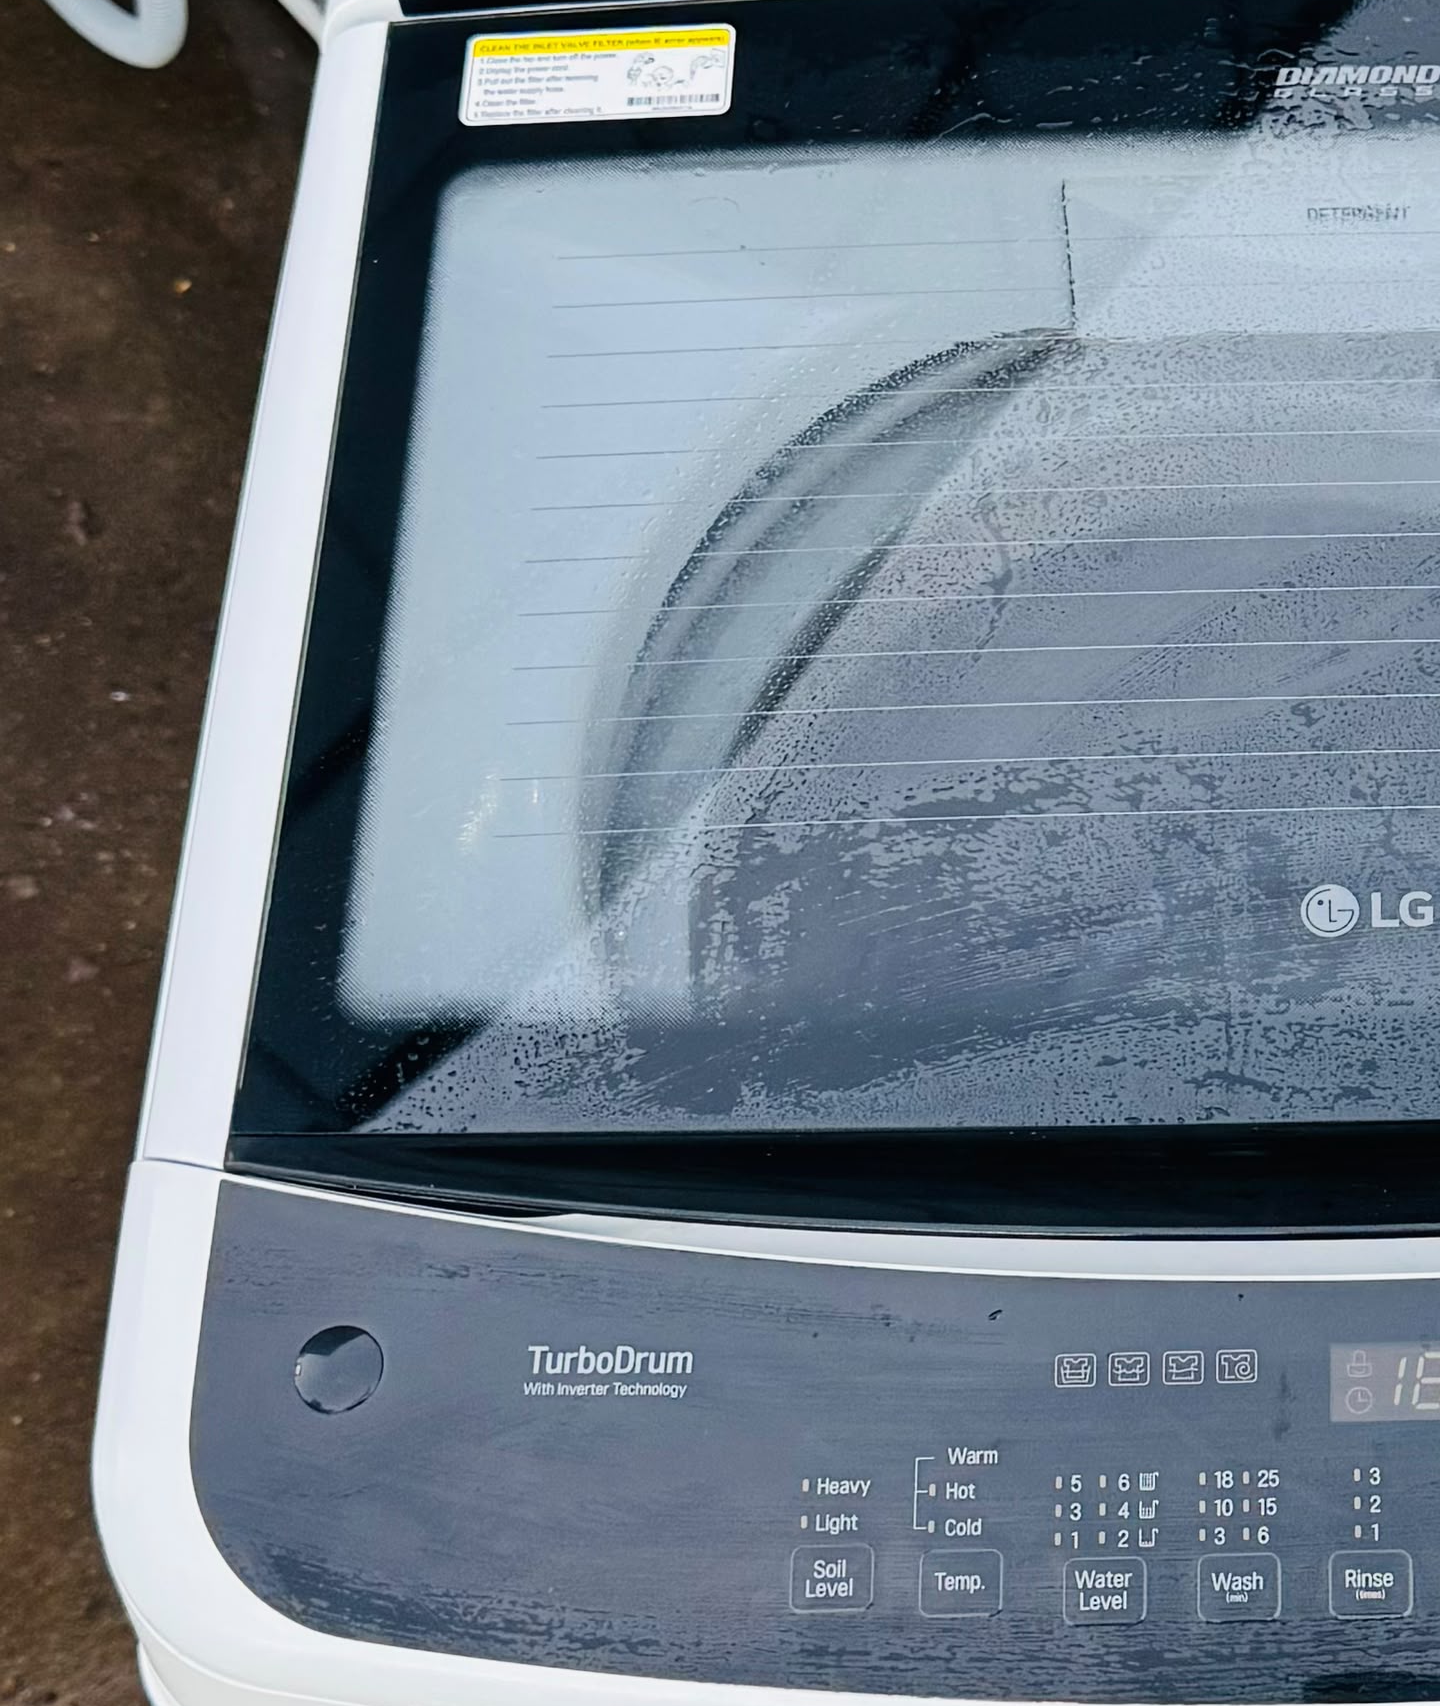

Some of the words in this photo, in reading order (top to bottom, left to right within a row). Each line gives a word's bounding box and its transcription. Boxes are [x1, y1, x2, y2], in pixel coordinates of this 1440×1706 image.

[593, 39, 624, 48] FILTER
[1371, 891, 1434, 928] LG
[527, 1345, 694, 1374] TurboDrum
[524, 1382, 554, 1395] With
[557, 1382, 609, 1396] Inverter
[613, 1382, 687, 1398] Technology
[948, 1447, 998, 1465] Warm
[1070, 1475, 1082, 1493] 5
[1117, 1473, 1130, 1491] 6
[1214, 1470, 1234, 1489] 18
[1257, 1469, 1280, 1488] 25
[1369, 1467, 1381, 1485] 3
[817, 1478, 871, 1496] Heavy
[946, 1483, 976, 1500] Hot
[1070, 1503, 1082, 1521] 3
[1117, 1501, 1130, 1519] 4
[1215, 1498, 1234, 1517] 10
[1258, 1497, 1277, 1516] 15
[1369, 1495, 1381, 1513] 2
[815, 1514, 858, 1535] Light
[945, 1519, 982, 1536] Cold
[1370, 1523, 1380, 1541] 1
[1070, 1531, 1079, 1549] 1
[1117, 1530, 1129, 1548] 2
[1214, 1527, 1226, 1545] 3
[1257, 1526, 1269, 1544] 6
[813, 1560, 847, 1579] Soil
[1344, 1568, 1394, 1588] Rinse
[805, 1578, 853, 1598] Level
[935, 1572, 985, 1594] Temp.
[1074, 1570, 1133, 1589] Water
[1211, 1571, 1264, 1592] Wash
[1079, 1591, 1127, 1611] Level
[1225, 1592, 1248, 1604] (min)
